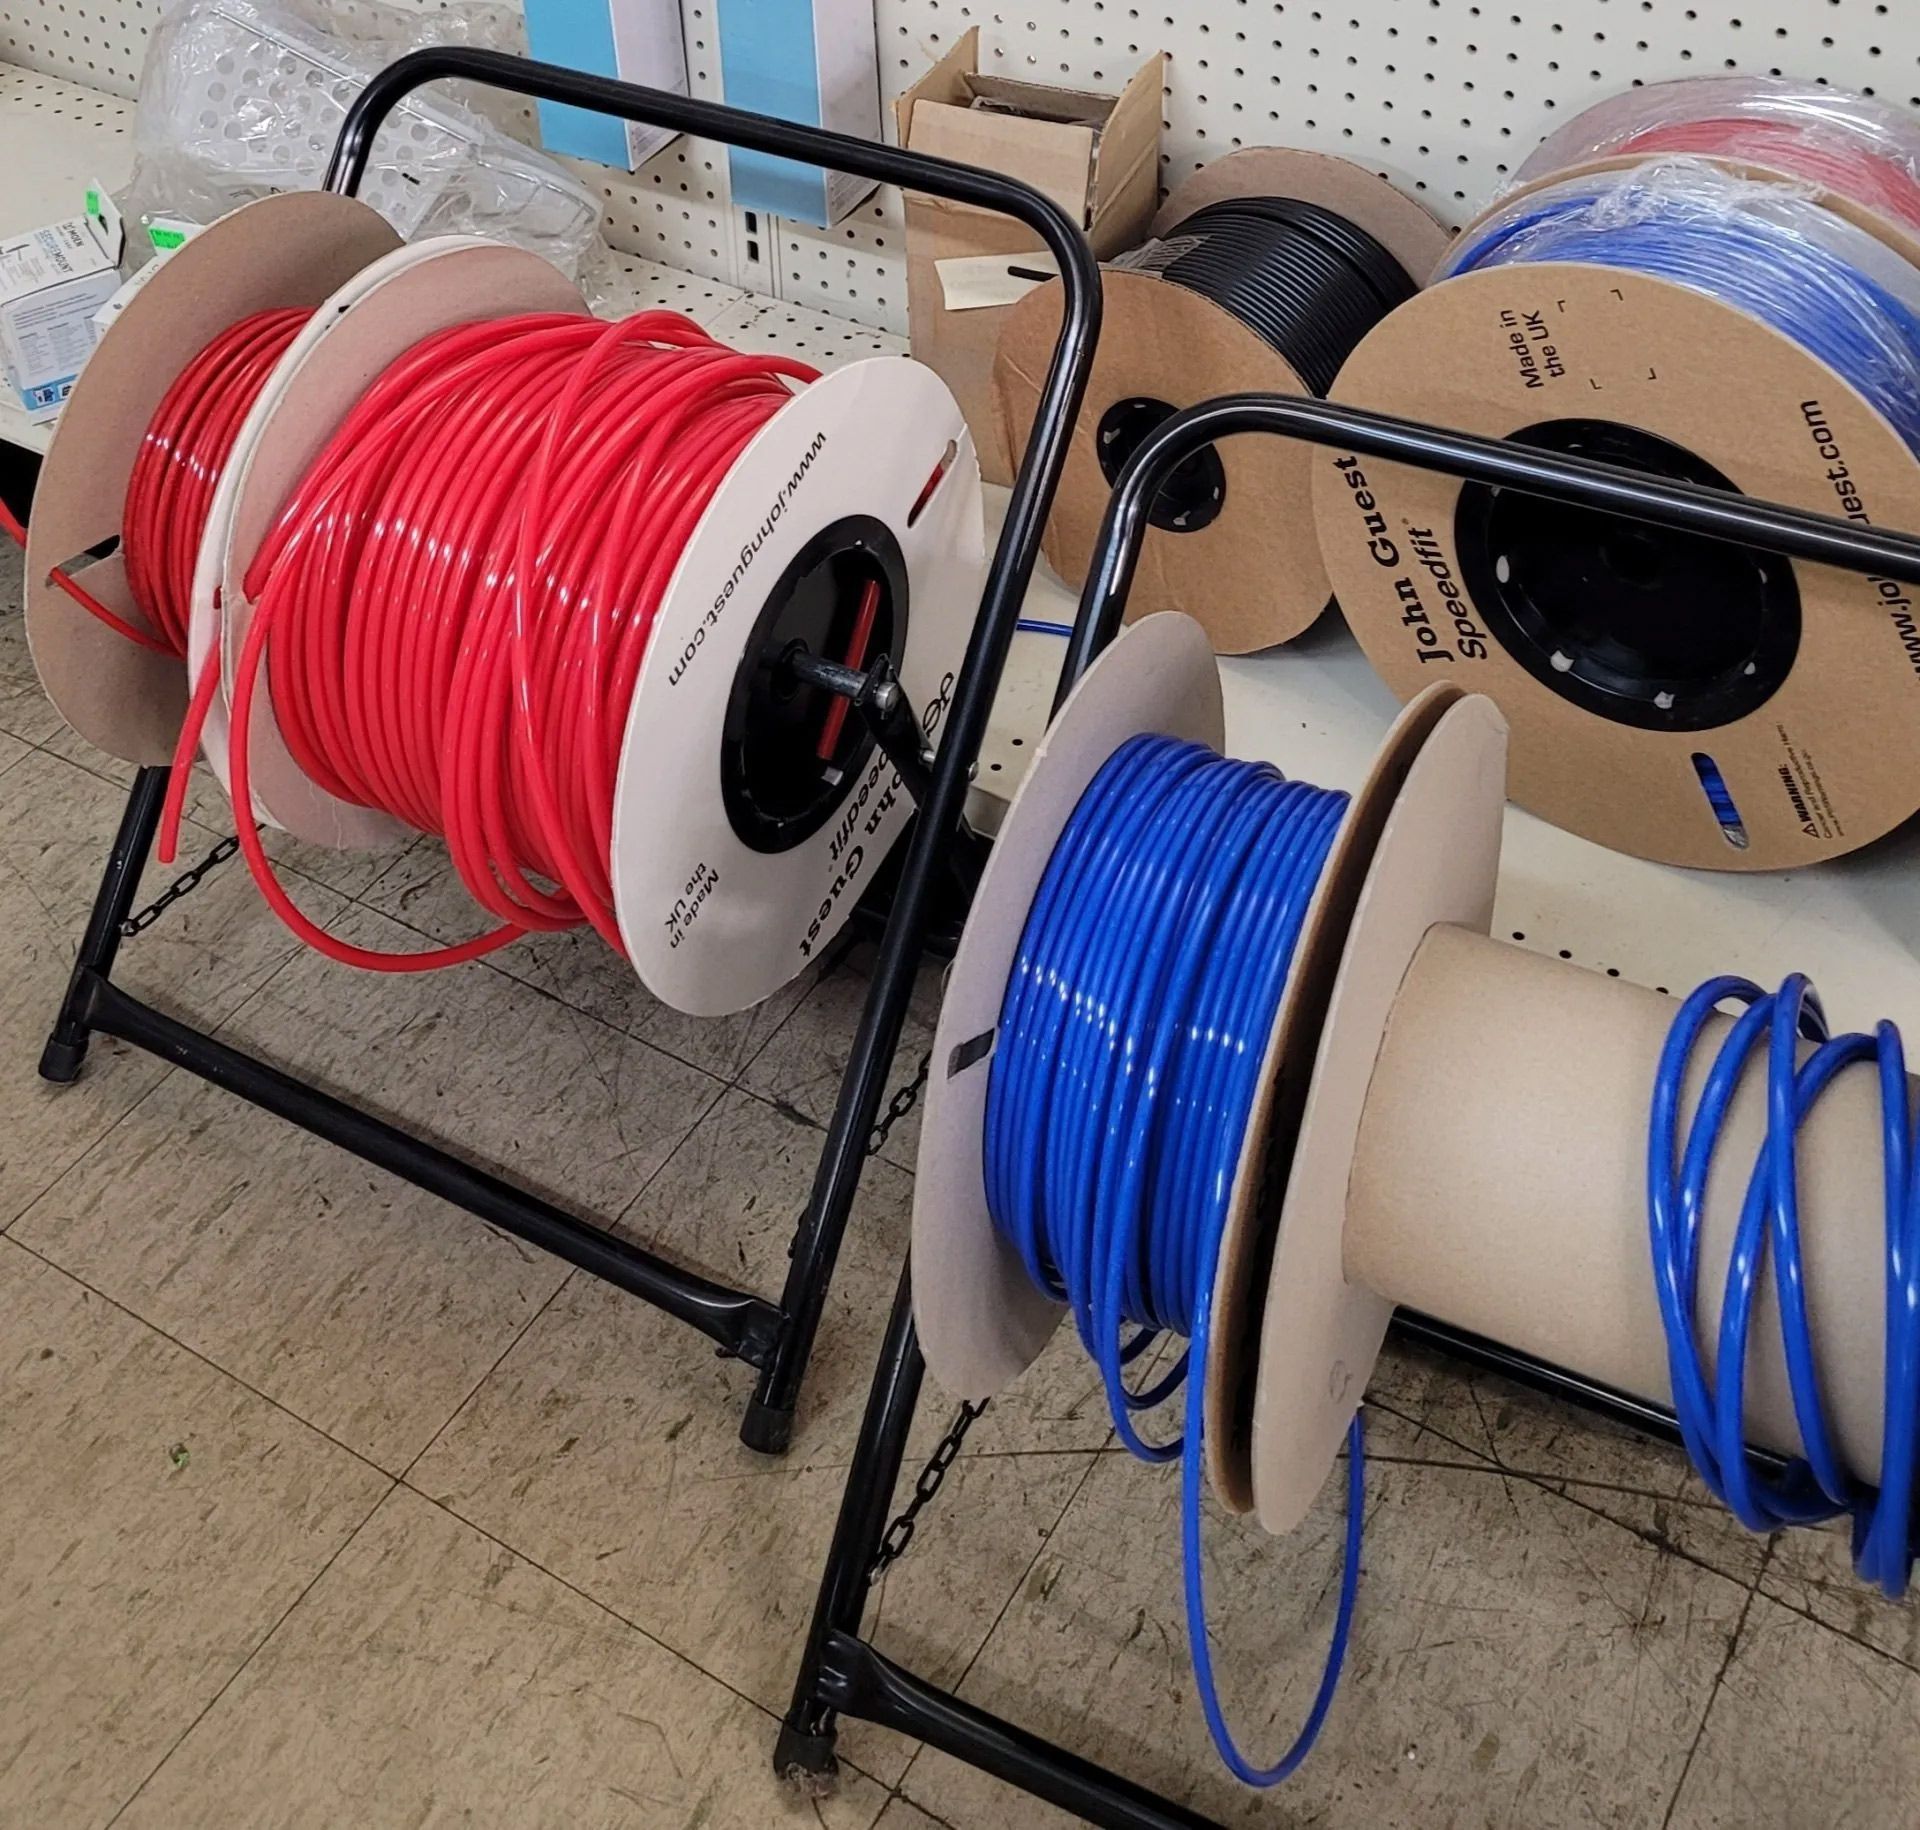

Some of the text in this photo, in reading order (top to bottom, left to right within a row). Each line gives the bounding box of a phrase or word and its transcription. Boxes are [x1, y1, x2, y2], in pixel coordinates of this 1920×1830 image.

[1499, 309, 1545, 389] Made in
[1521, 309, 1566, 378] the UK
[668, 431, 828, 687] www.johnguest.com
[1332, 455, 1456, 664] John Guest
[1407, 527, 1488, 660] Speedfit
[829, 752, 889, 861] peedfit
[1778, 763, 1813, 823] WARNING:
[664, 862, 707, 933] the UK
[670, 868, 720, 948] Made in
[799, 771, 902, 957] ohn Guest
